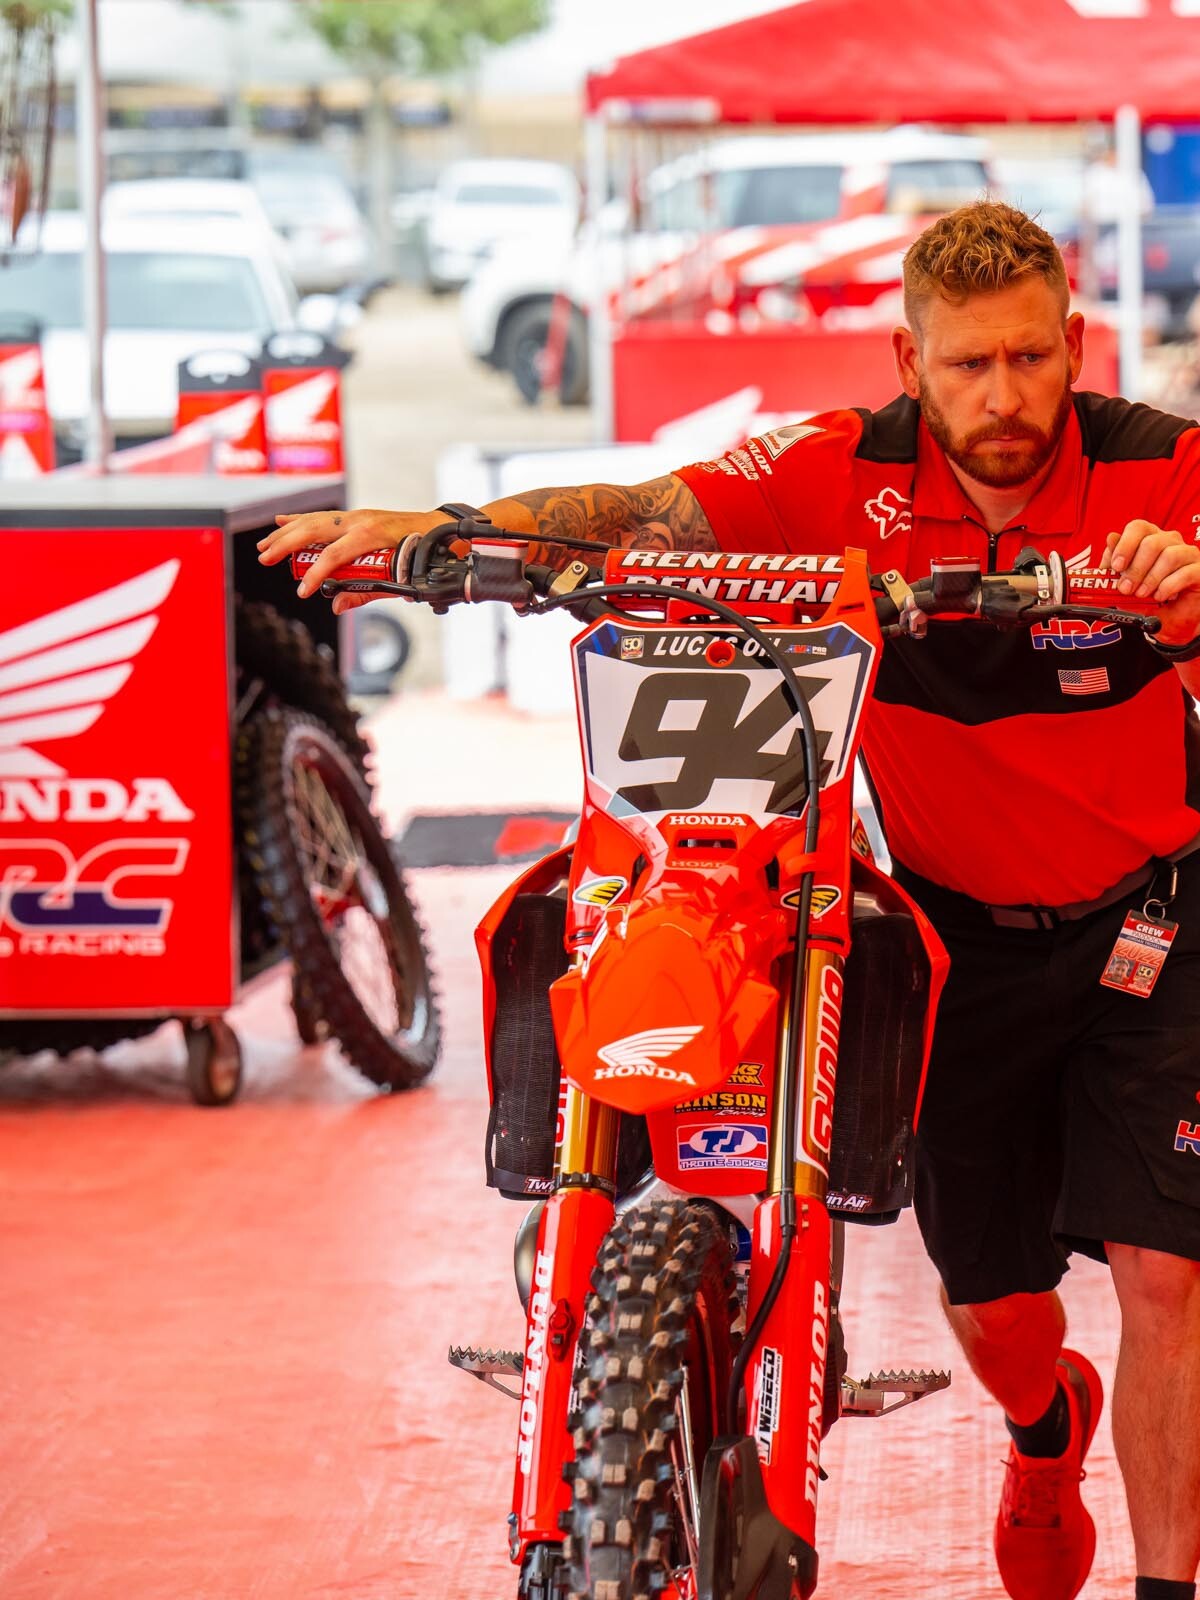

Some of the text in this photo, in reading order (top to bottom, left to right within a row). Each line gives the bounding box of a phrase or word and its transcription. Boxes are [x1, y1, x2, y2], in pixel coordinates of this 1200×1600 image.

[620, 551, 846, 573] RENTHAL
[1069, 577, 1119, 590] RENT
[1030, 617, 1122, 650] HRC
[616, 672, 835, 818] 94
[0, 777, 196, 822] NDA
[669, 815, 747, 827] HONDA
[1136, 923, 1165, 938] CREW
[19, 934, 166, 957] RACING
[1114, 942, 1162, 968] 2022
[593, 1065, 697, 1086] HONDA
[701, 1130, 745, 1153] TJ
[681, 1159, 768, 1169] THROTTLE JOCKEY
[843, 1195, 870, 1208] Air
[518, 1250, 554, 1476] DUNLOP
[804, 1280, 828, 1513] DUNLOP
